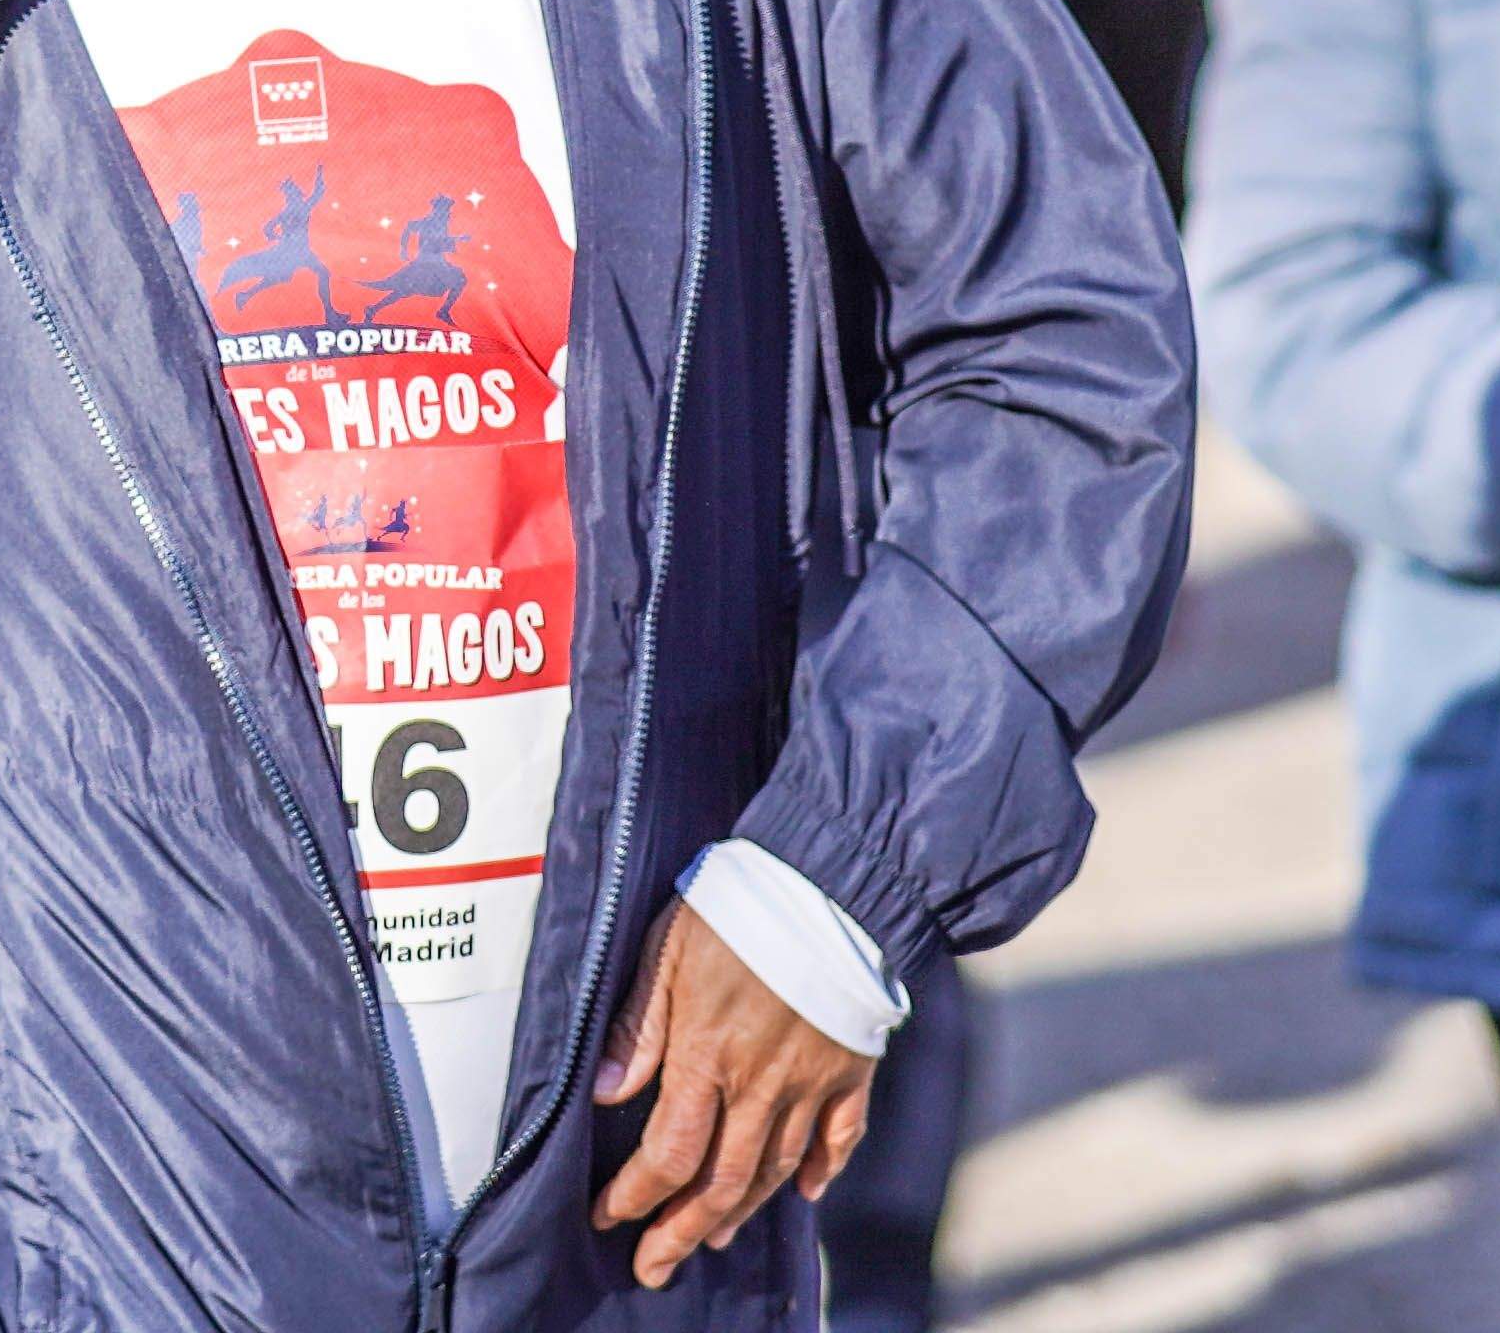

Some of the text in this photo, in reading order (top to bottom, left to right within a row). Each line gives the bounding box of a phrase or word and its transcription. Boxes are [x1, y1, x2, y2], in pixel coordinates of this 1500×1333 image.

[316, 328, 472, 355] POPULAR
[285, 363, 336, 383] de los
[322, 369, 516, 452] MAGOS
[365, 563, 504, 590] POPULAR
[337, 591, 386, 609] de los
[363, 601, 546, 693] MAGOS
[326, 717, 470, 855] 6
